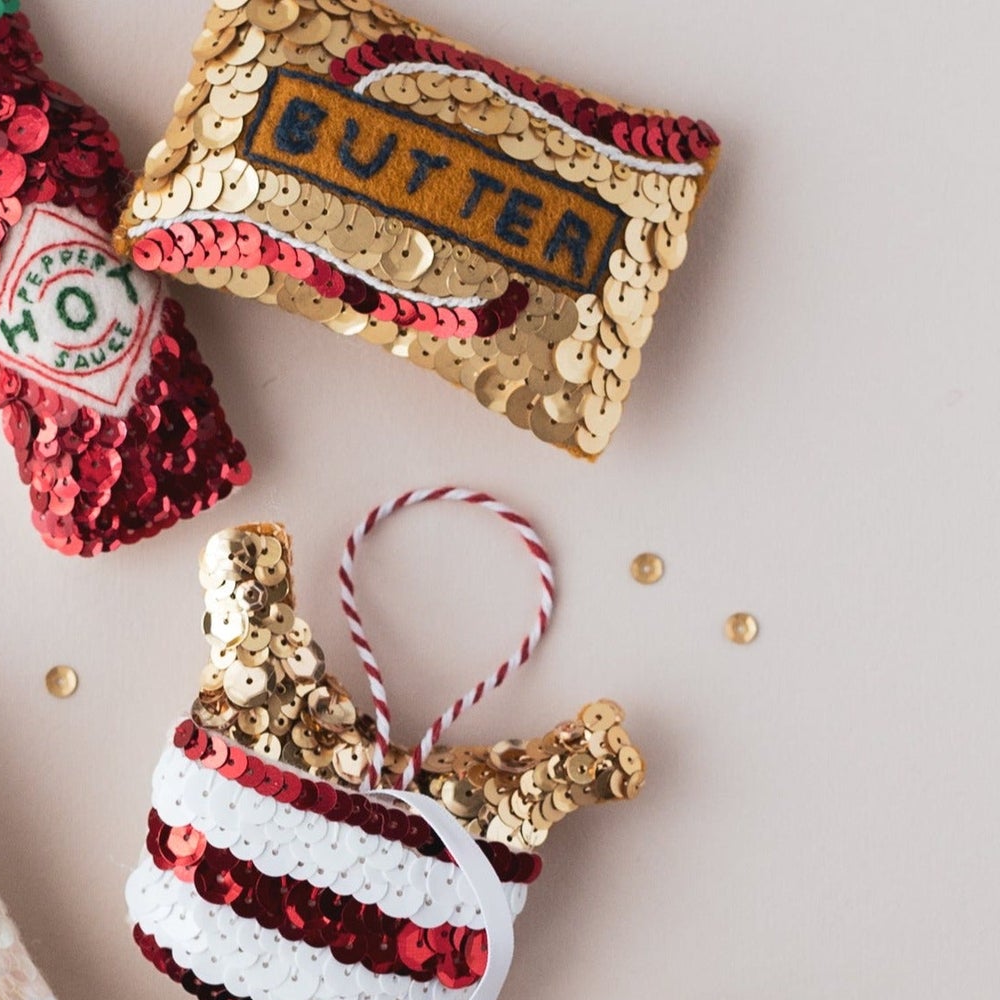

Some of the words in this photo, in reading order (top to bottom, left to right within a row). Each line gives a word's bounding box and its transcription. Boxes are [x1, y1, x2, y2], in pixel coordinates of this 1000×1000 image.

[275, 96, 592, 279] BUTTER
[0, 264, 138, 354] HOT
[54, 322, 132, 370] SAUCE
